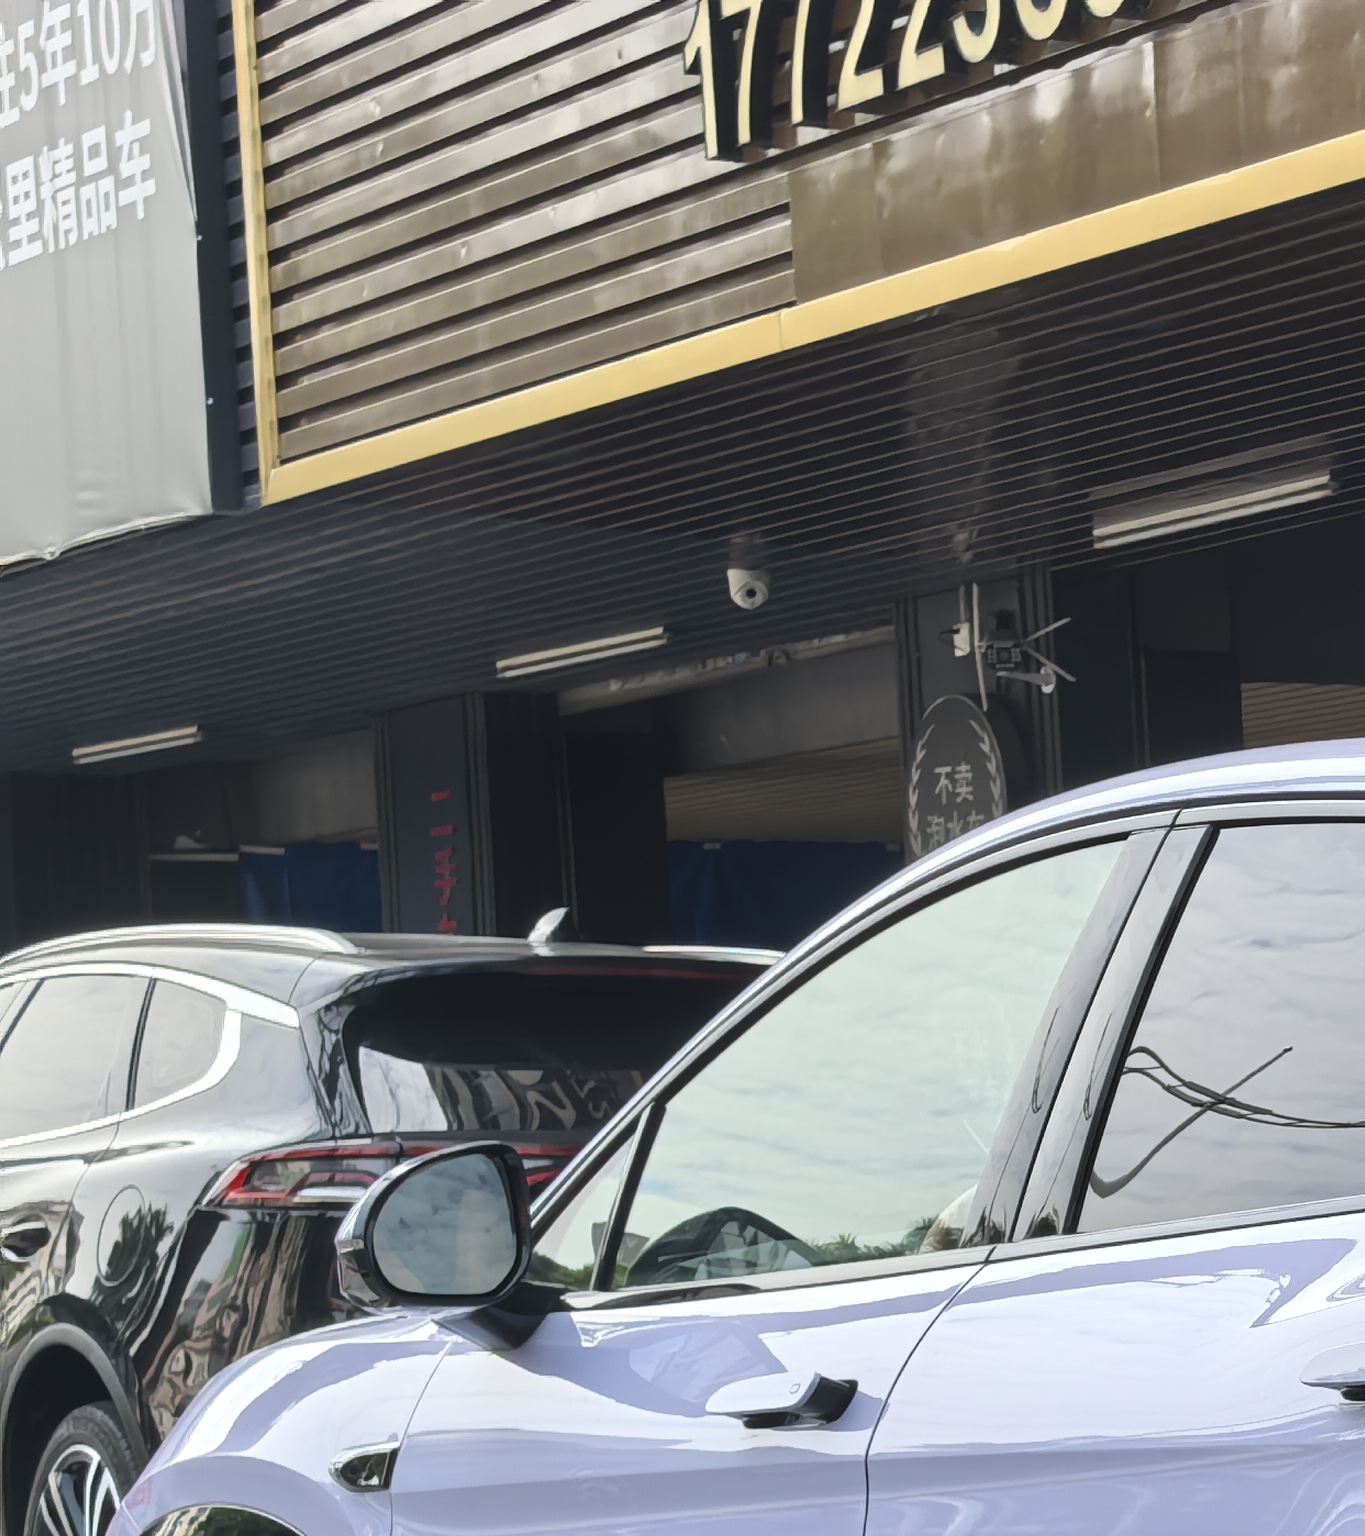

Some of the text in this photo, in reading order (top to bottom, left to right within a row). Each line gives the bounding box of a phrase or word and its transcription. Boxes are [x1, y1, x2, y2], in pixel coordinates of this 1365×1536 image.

[0, 109, 157, 270] 里精品车
[934, 761, 974, 806] 不卖
